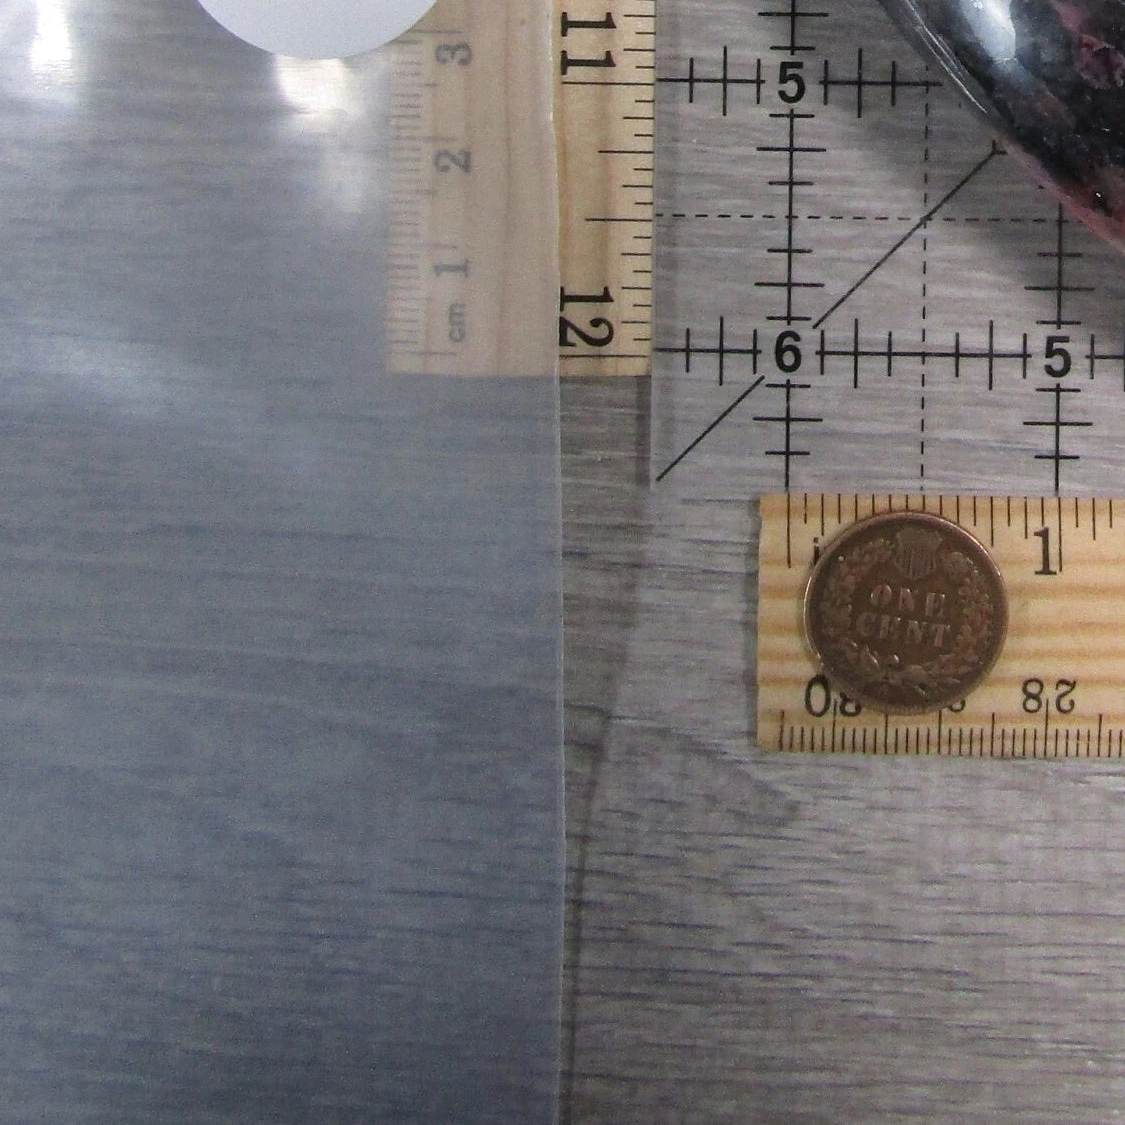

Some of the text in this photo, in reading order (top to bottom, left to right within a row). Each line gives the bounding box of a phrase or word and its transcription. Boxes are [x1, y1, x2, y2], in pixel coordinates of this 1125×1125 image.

[435, 41, 473, 66] 3
[560, 11, 617, 75] 11
[777, 61, 806, 104] 5
[434, 149, 472, 173] 2
[558, 286, 615, 347] 12
[773, 331, 802, 373] 6
[1043, 334, 1072, 377] 5
[1034, 527, 1057, 575] 1
[1021, 678, 1077, 715] 28
